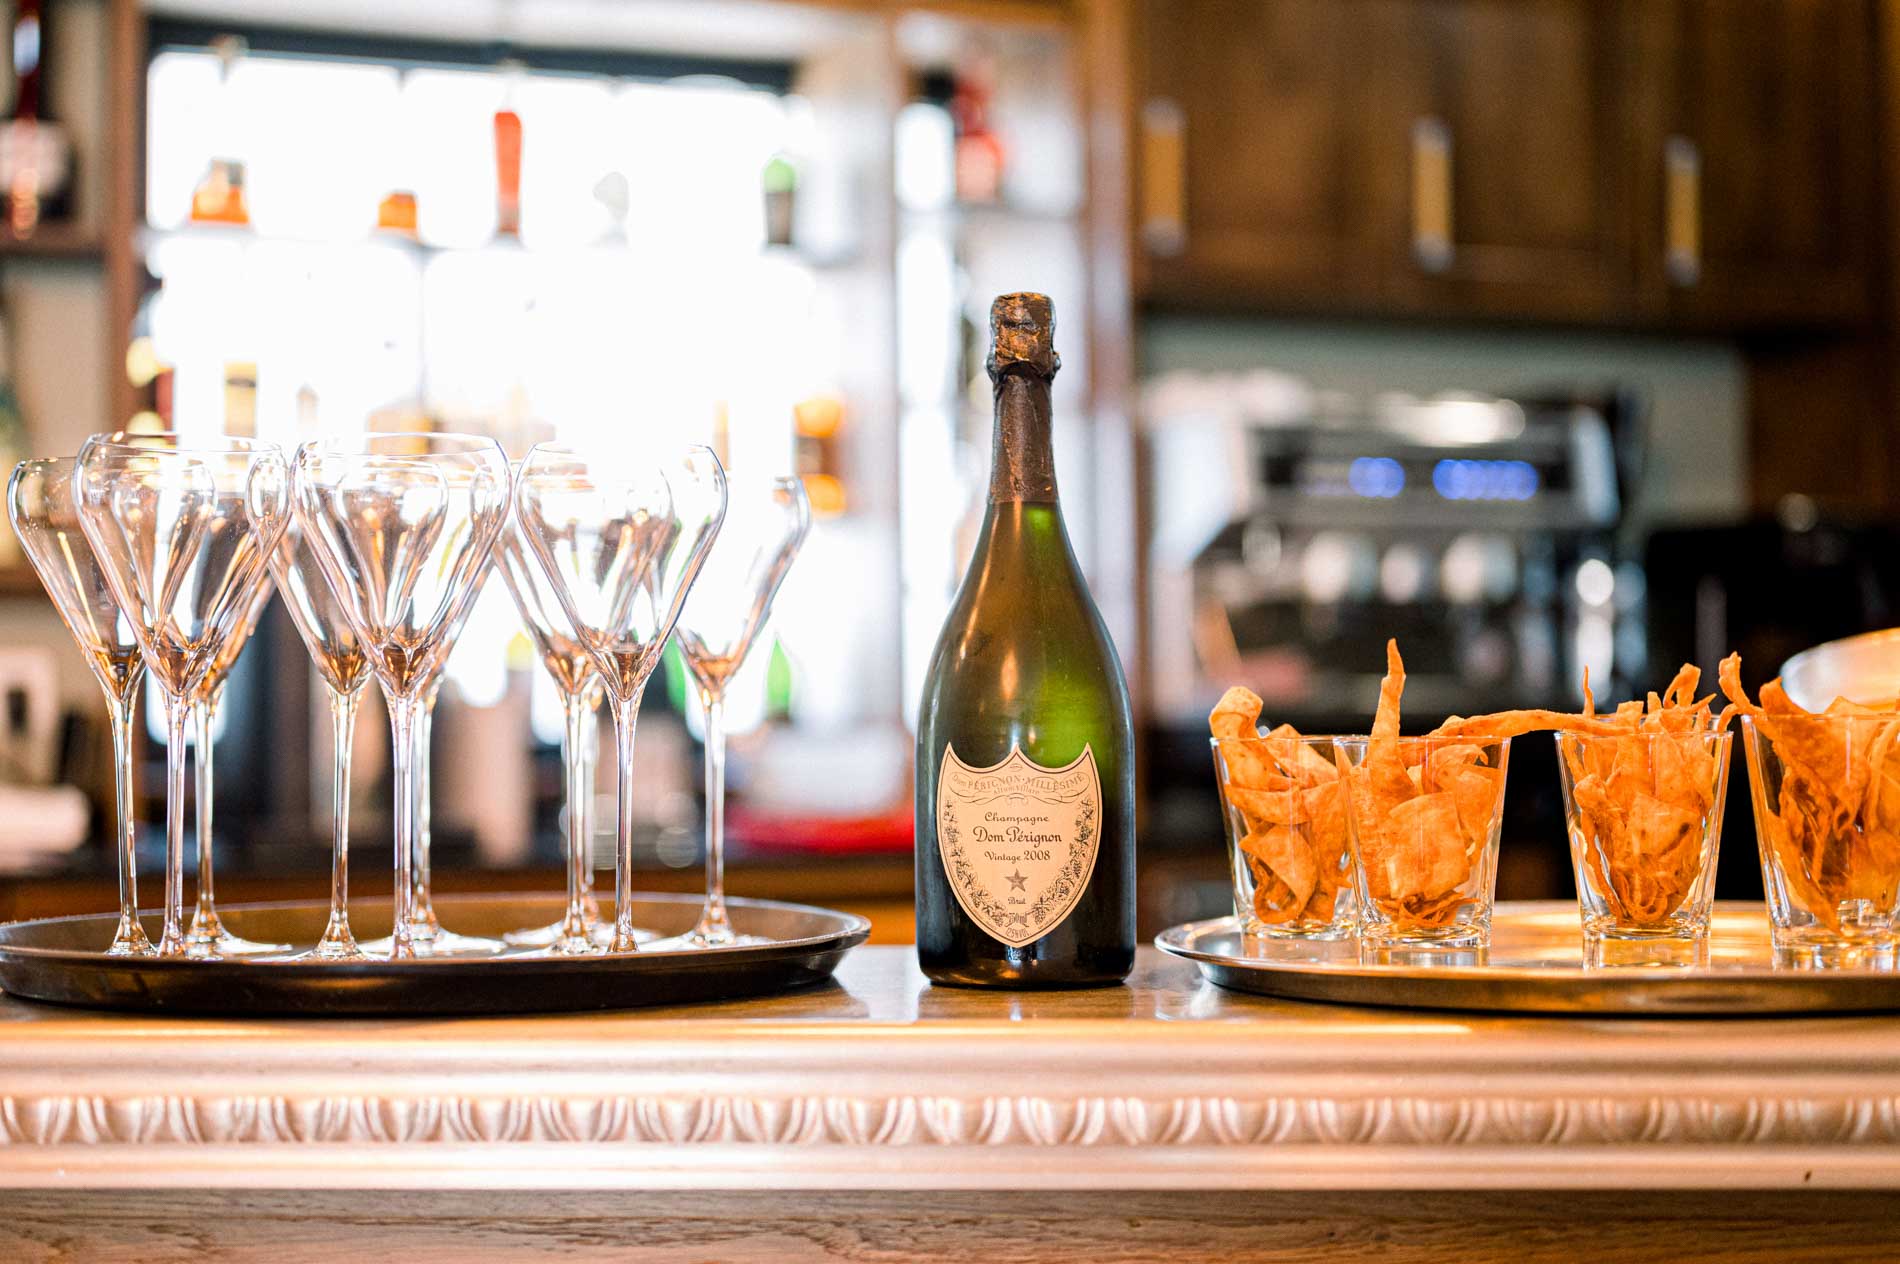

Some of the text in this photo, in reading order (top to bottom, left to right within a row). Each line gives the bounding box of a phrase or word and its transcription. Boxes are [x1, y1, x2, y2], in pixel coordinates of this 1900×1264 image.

[984, 811, 1049, 825] Champagne
[972, 825, 1062, 848] Dom Pérignon
[984, 850, 1051, 864] Vintage 2008
[1007, 896, 1026, 904] Brut
